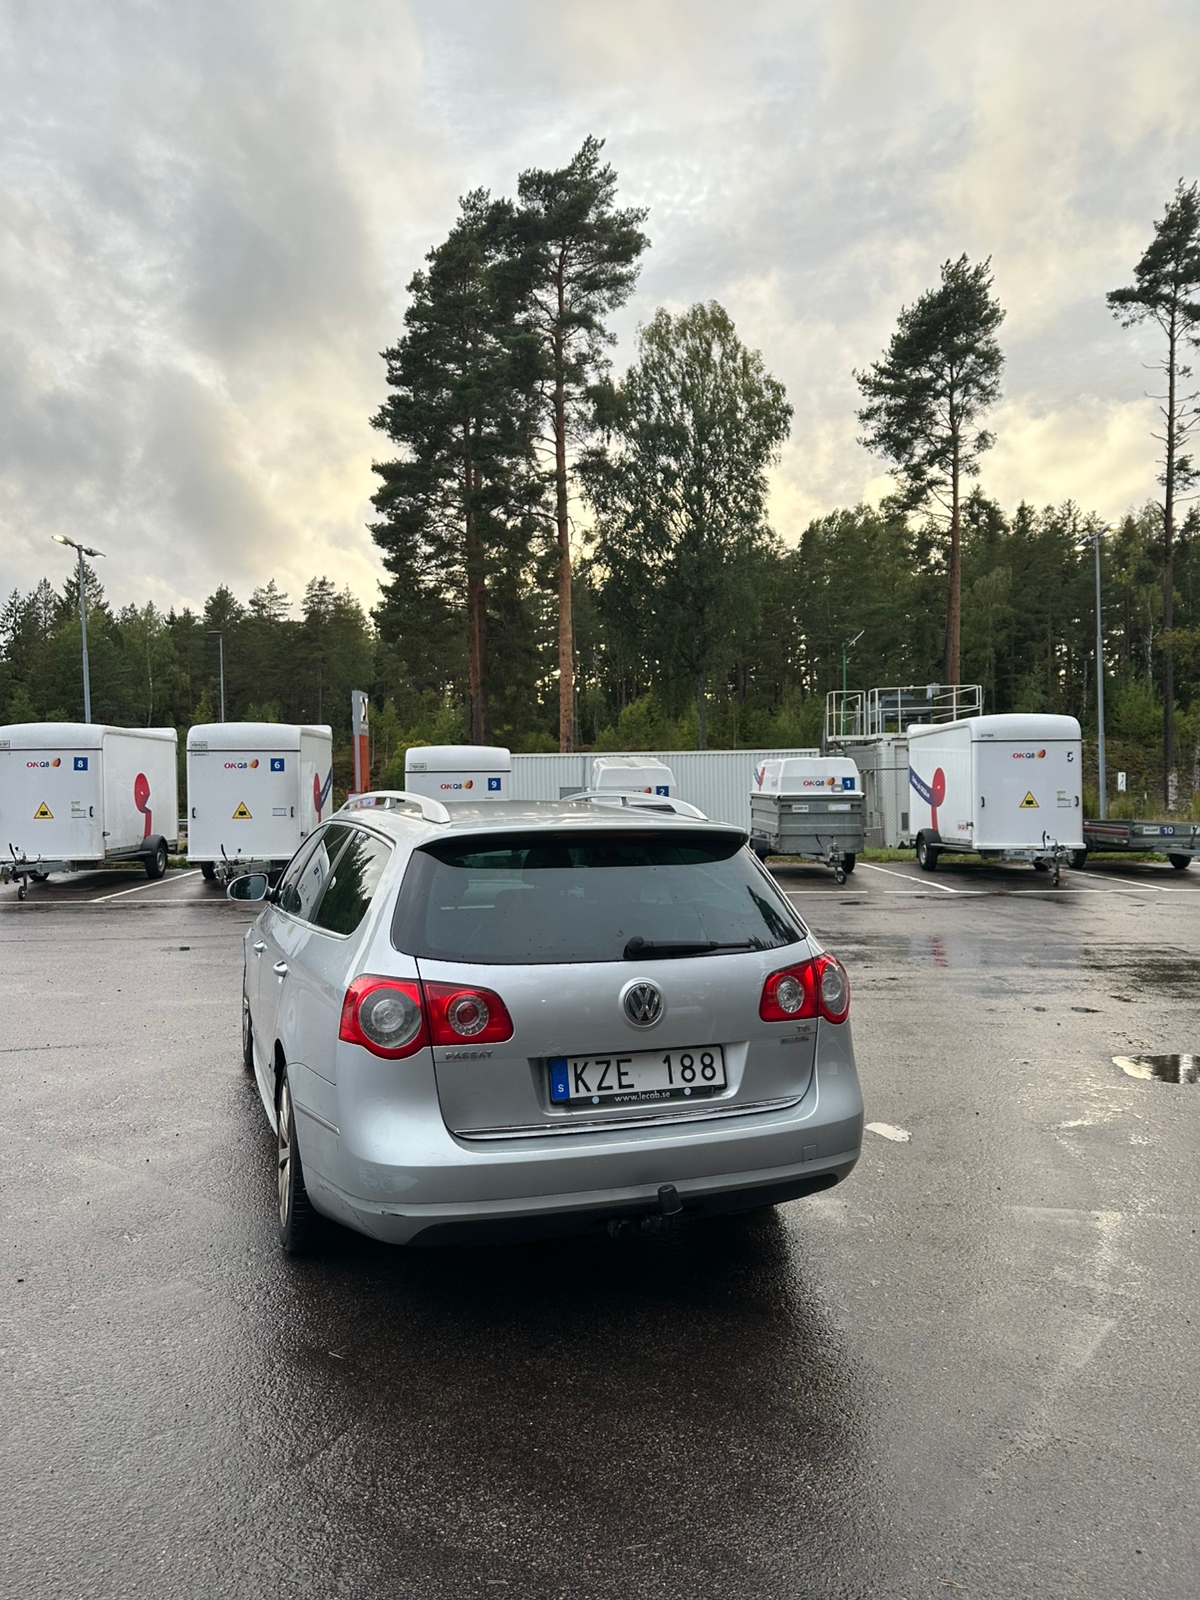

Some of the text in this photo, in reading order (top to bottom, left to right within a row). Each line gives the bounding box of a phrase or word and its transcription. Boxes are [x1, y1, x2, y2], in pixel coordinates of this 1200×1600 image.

[77, 760, 84, 768] 8
[274, 761, 281, 770] 6
[491, 780, 498, 789] 9
[845, 780, 851, 788] 1
[659, 788, 666, 796] 2
[1163, 827, 1174, 835] 10
[445, 1050, 493, 1060] PASSAT
[573, 1052, 717, 1094] KZE 188
[558, 1084, 565, 1093] S
[614, 1090, 671, 1102] www.lecab.se
